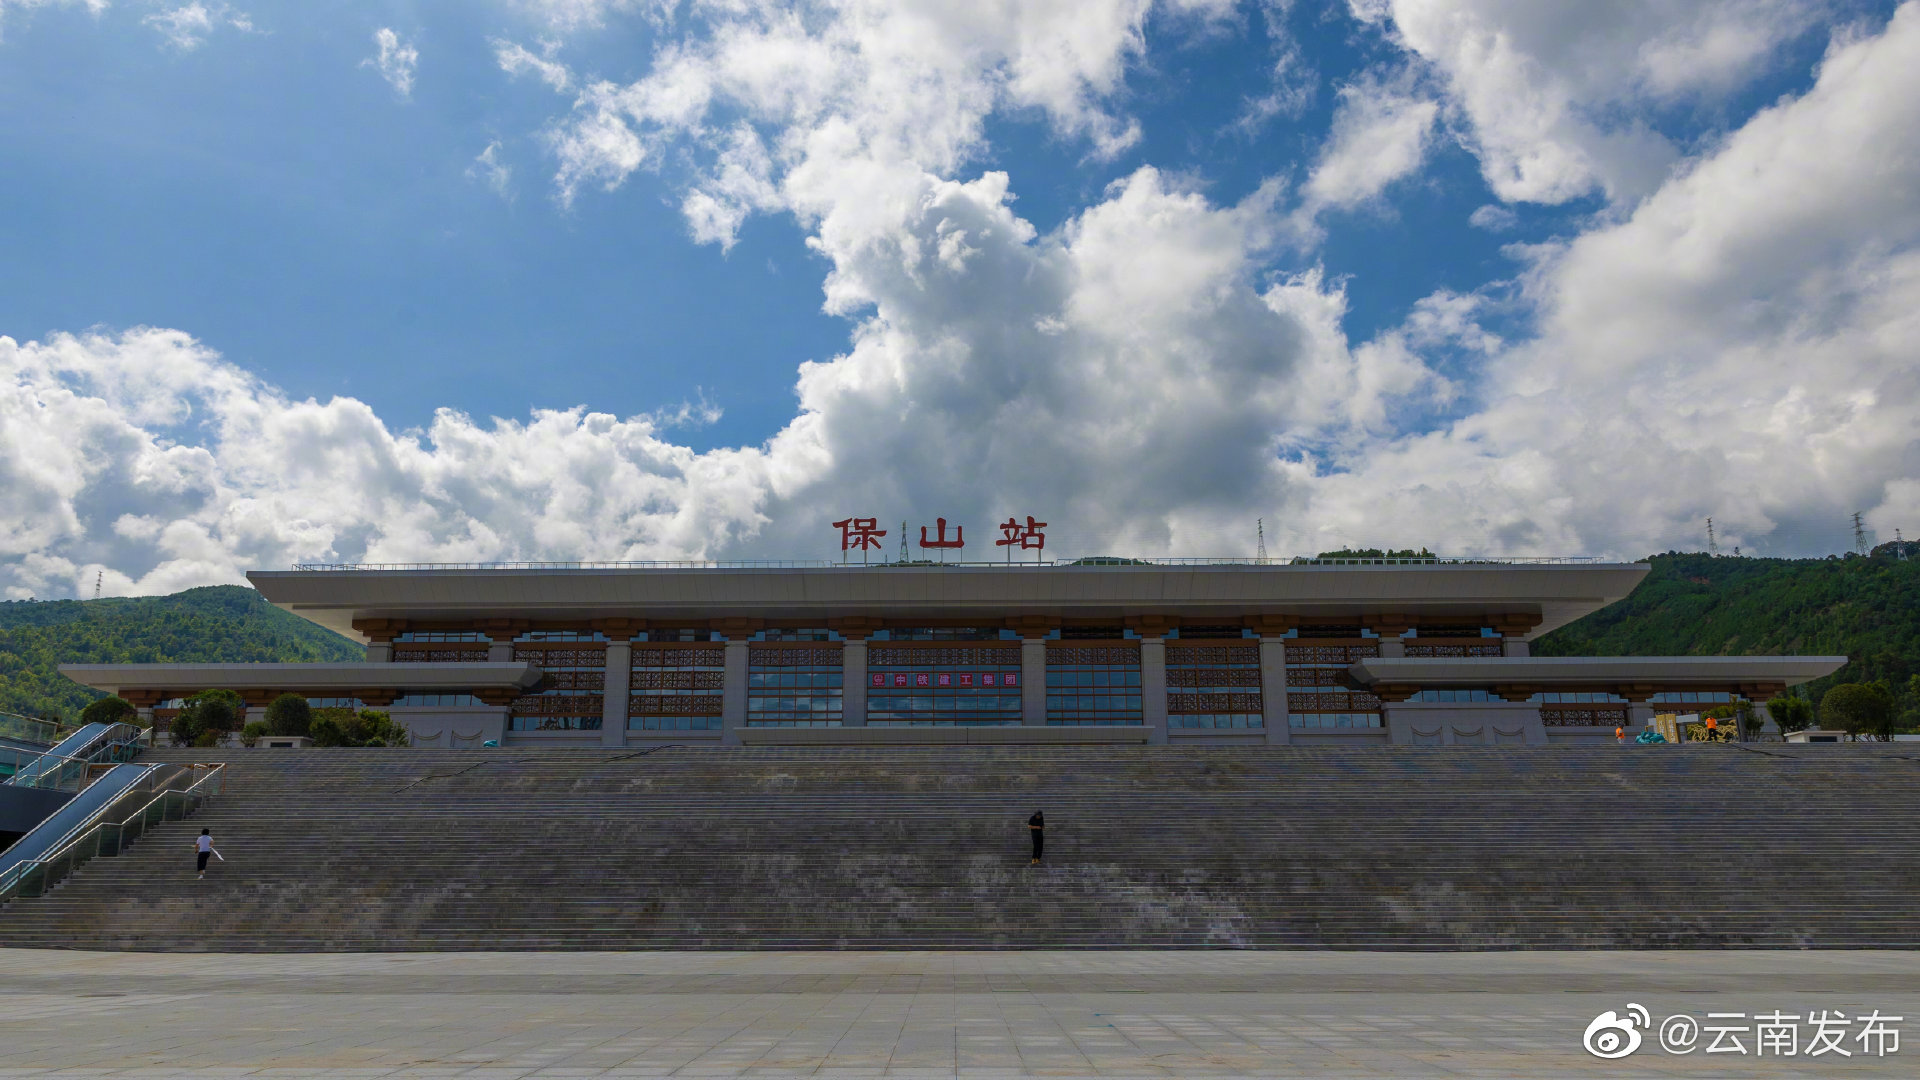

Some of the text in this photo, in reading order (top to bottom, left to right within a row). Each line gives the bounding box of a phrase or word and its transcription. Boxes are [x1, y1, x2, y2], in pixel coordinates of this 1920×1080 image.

[832, 516, 1047, 551] 保山站
[895, 674, 1016, 686] 中铁建工集团
